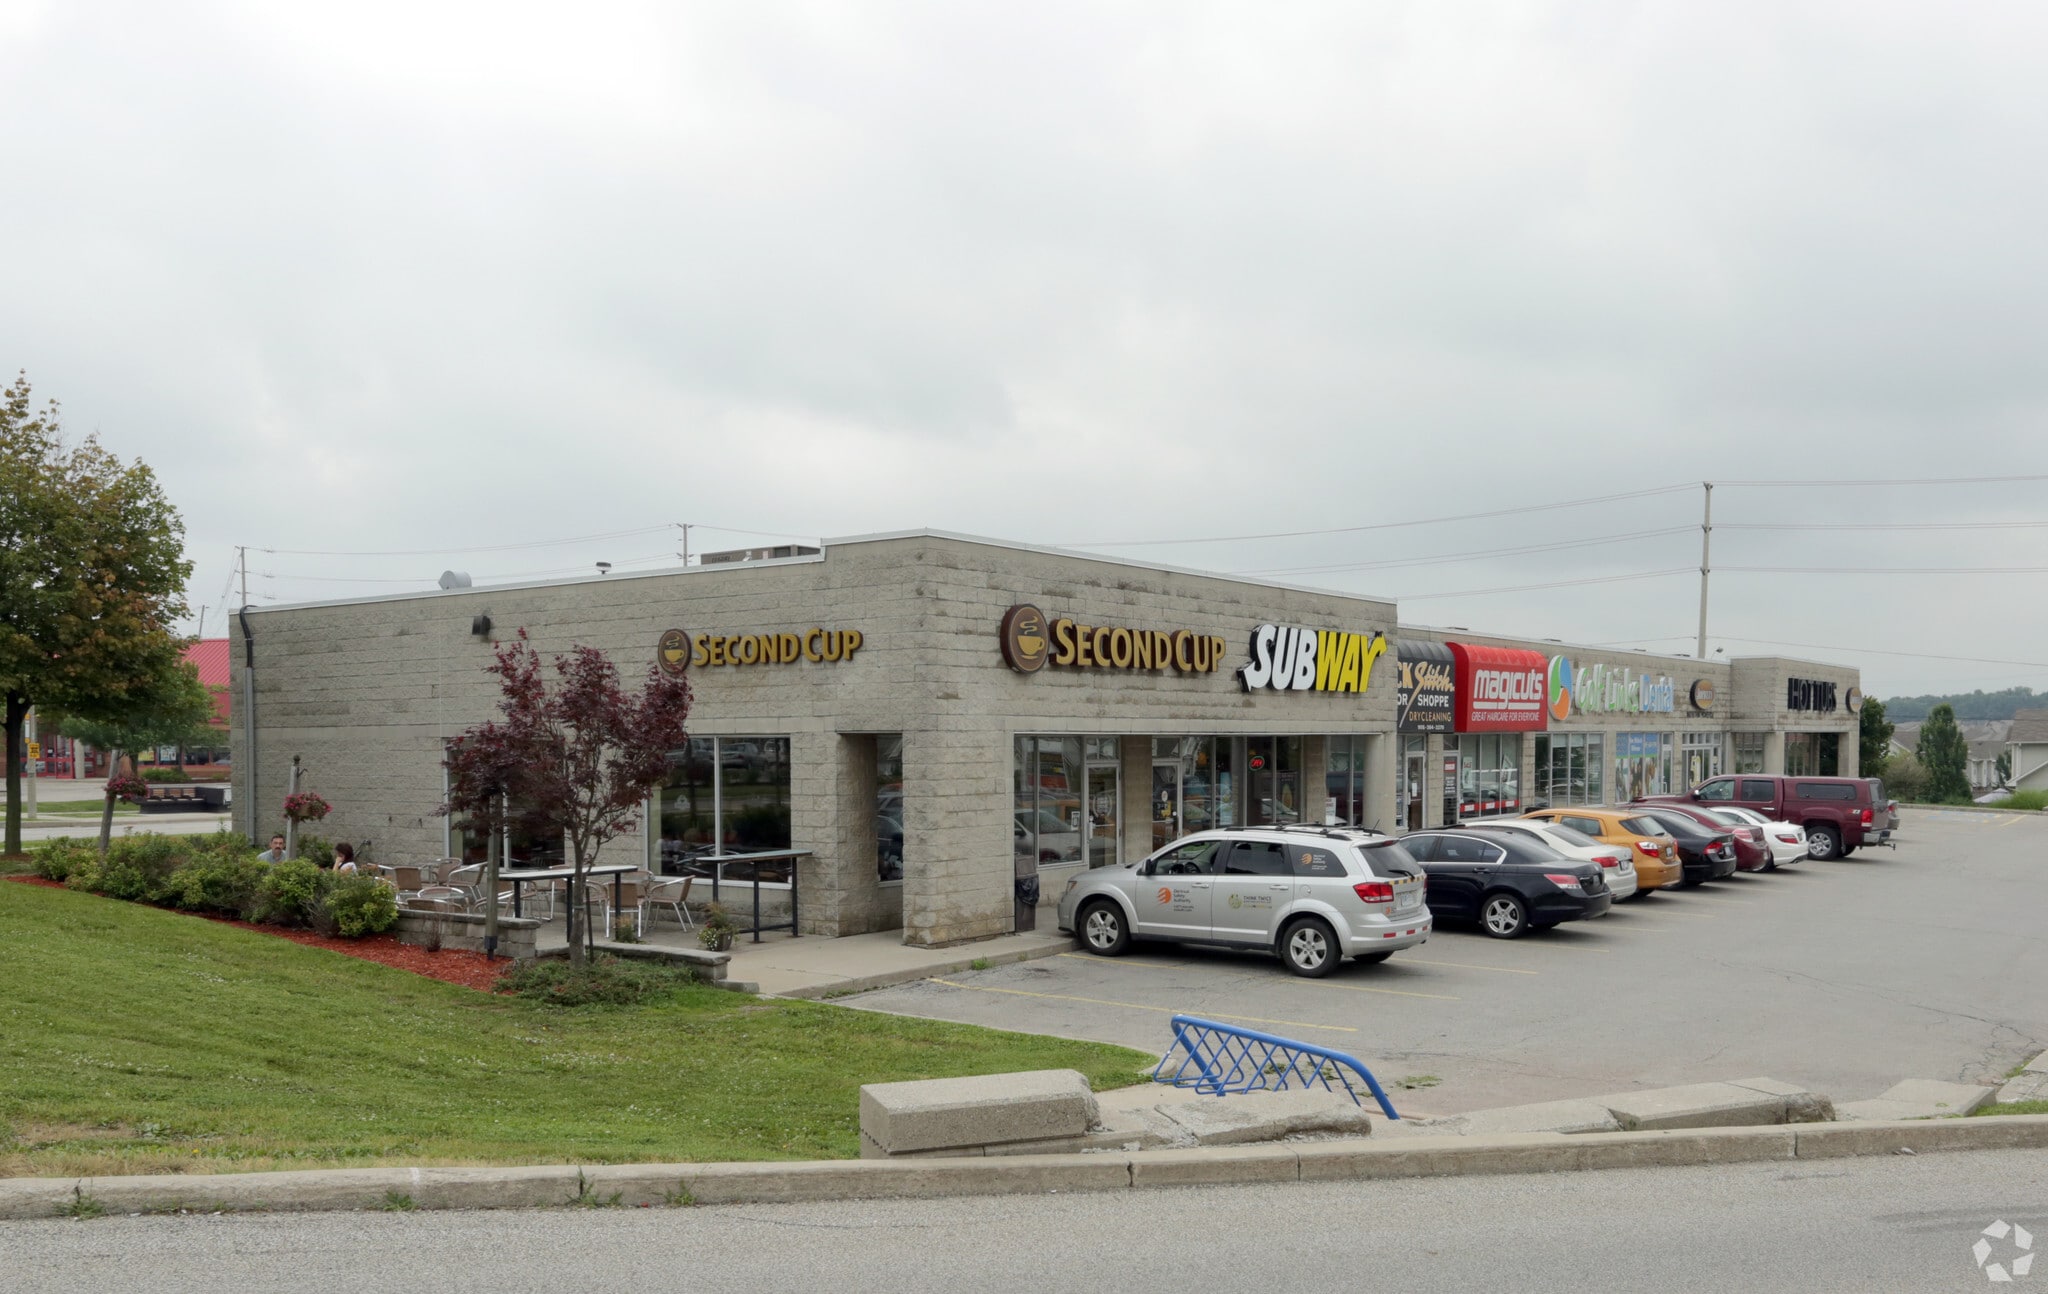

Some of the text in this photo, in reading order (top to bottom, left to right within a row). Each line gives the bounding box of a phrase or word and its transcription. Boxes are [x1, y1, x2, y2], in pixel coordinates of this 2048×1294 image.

[692, 626, 863, 668] SECOND CUP
[1049, 617, 1227, 673] SECOND CUP
[1237, 623, 1388, 693] SUBWAY
[1417, 694, 1450, 708] SHOPPE
[1473, 668, 1544, 710] magicuts
[1575, 663, 1675, 715] Golf Links Dental
[1787, 678, 1838, 712] HOT TUBS
[1408, 711, 1452, 722] DRYCLEANING
[1471, 711, 1540, 722] GREAT HAIRCARE FOR EVERYONE
